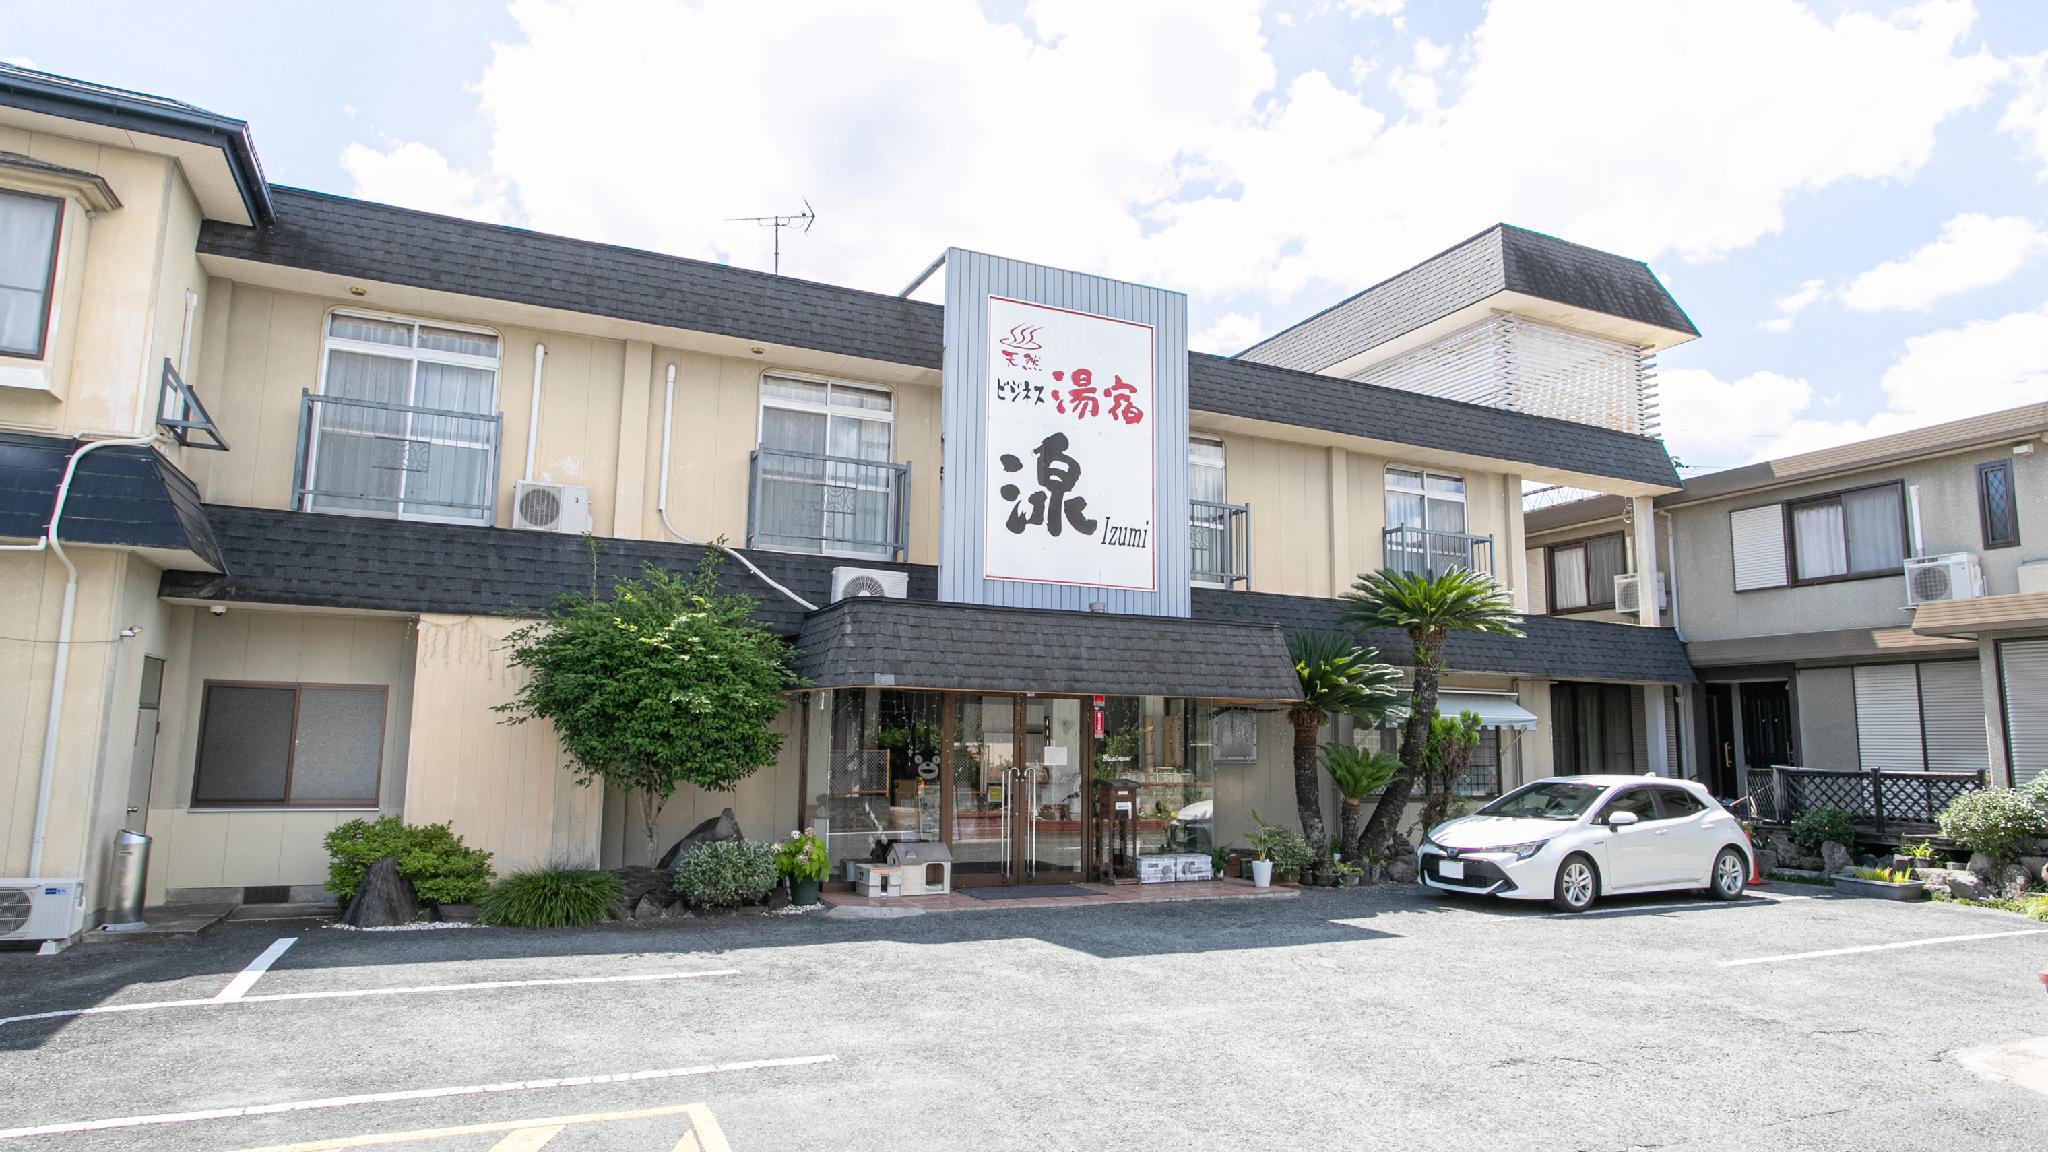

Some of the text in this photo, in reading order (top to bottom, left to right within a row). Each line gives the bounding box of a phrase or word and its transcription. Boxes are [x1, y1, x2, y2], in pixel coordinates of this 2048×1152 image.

[1001, 350, 1042, 371] 天然
[997, 368, 1144, 425] ビジネス 湯宿
[1101, 516, 1150, 549] Izumi
